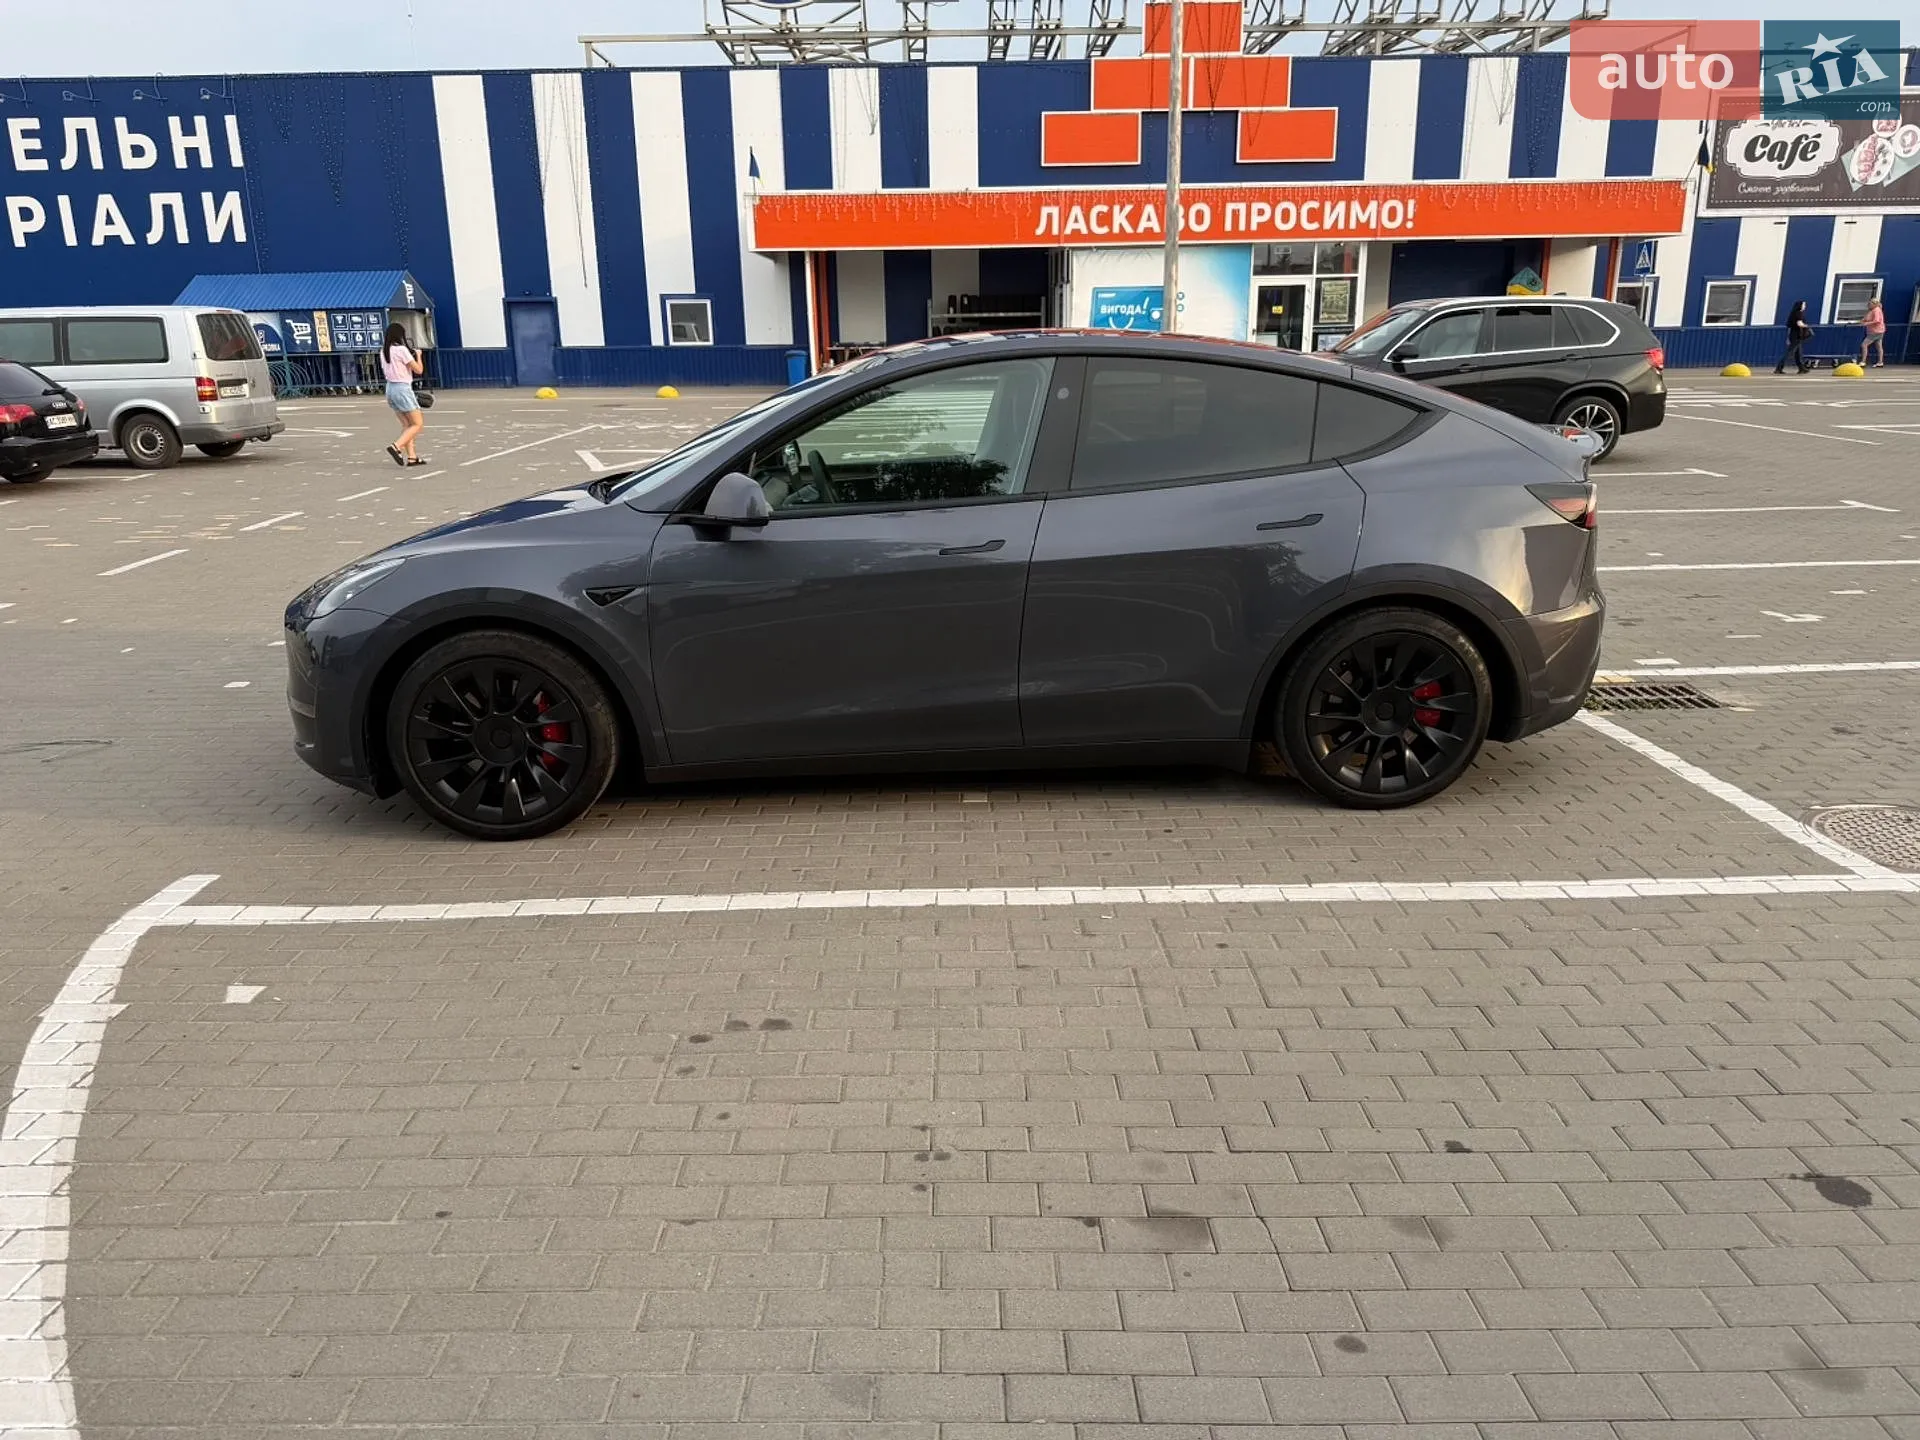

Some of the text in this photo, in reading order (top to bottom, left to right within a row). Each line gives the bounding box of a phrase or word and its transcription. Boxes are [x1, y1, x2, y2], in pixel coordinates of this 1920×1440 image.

[7, 114, 244, 171] ЕЛЬНІ
[1744, 132, 1822, 171] Café
[5, 190, 247, 248] РІАЛИ
[1224, 198, 1418, 231] ПРОСИМО!
